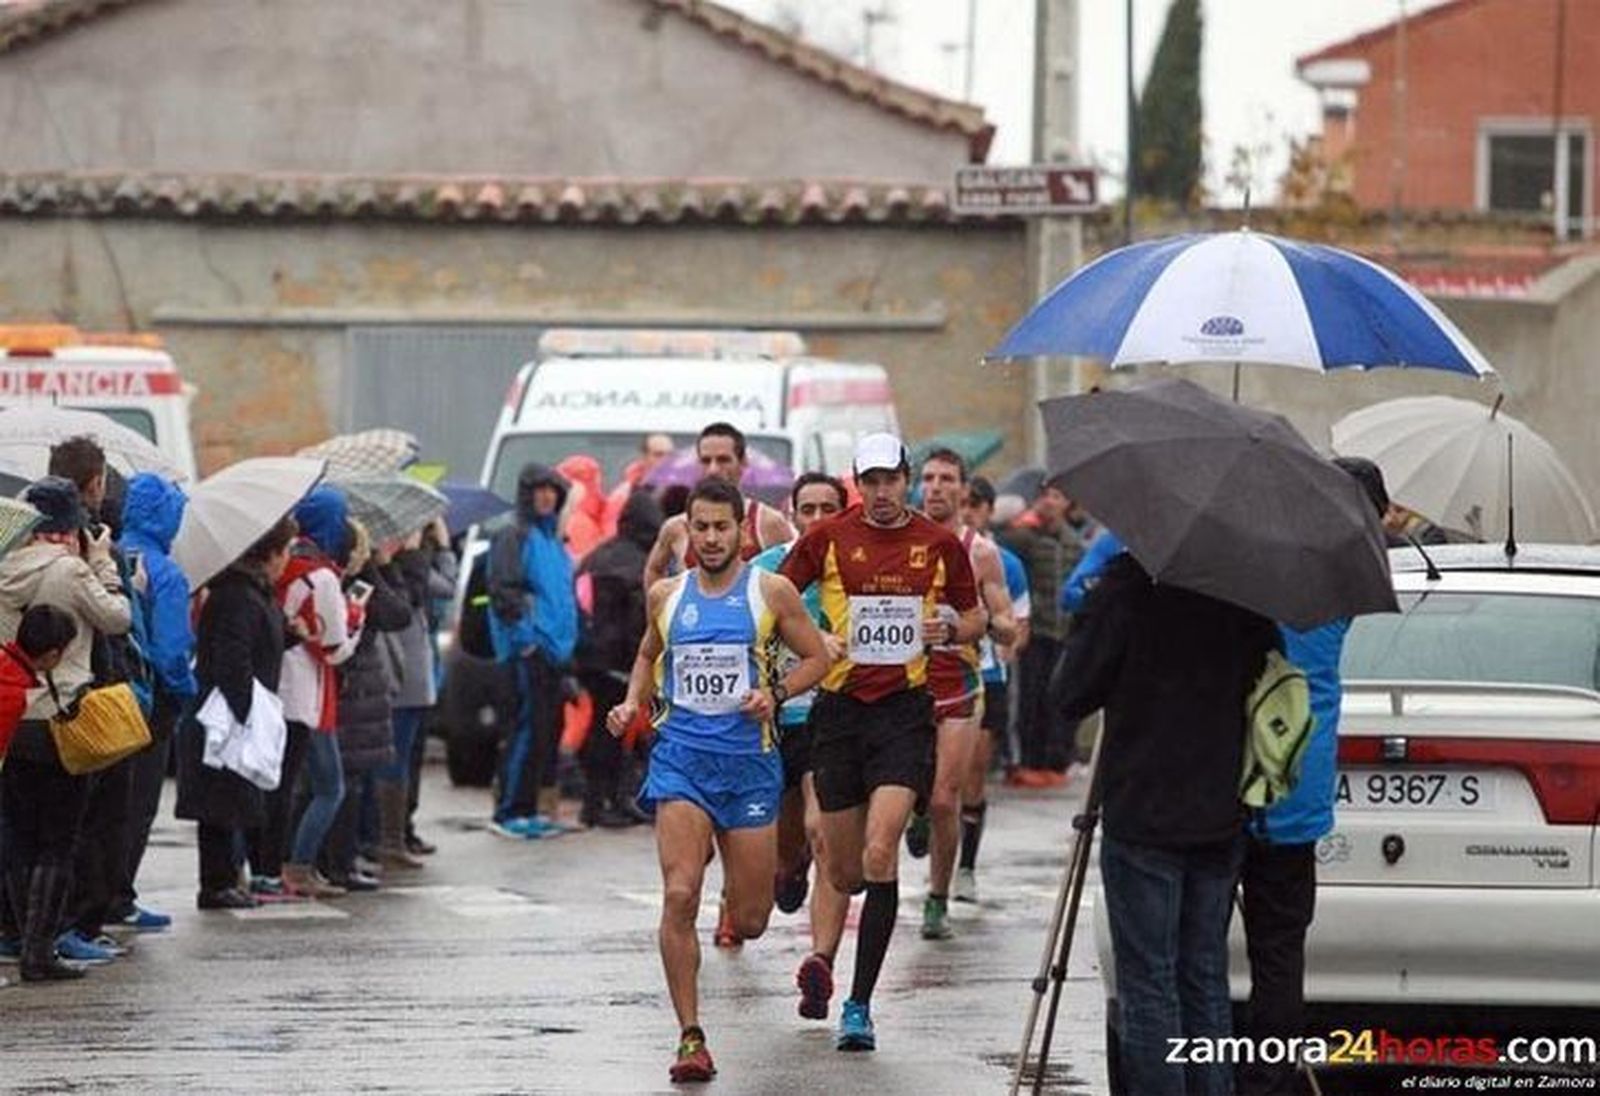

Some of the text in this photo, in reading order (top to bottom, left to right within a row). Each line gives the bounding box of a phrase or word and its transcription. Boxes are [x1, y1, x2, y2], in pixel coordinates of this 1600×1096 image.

[858, 624, 915, 645] 0400
[683, 673, 740, 696] 1097
[1367, 774, 1447, 805] 9367
[1460, 775, 1480, 805] S
